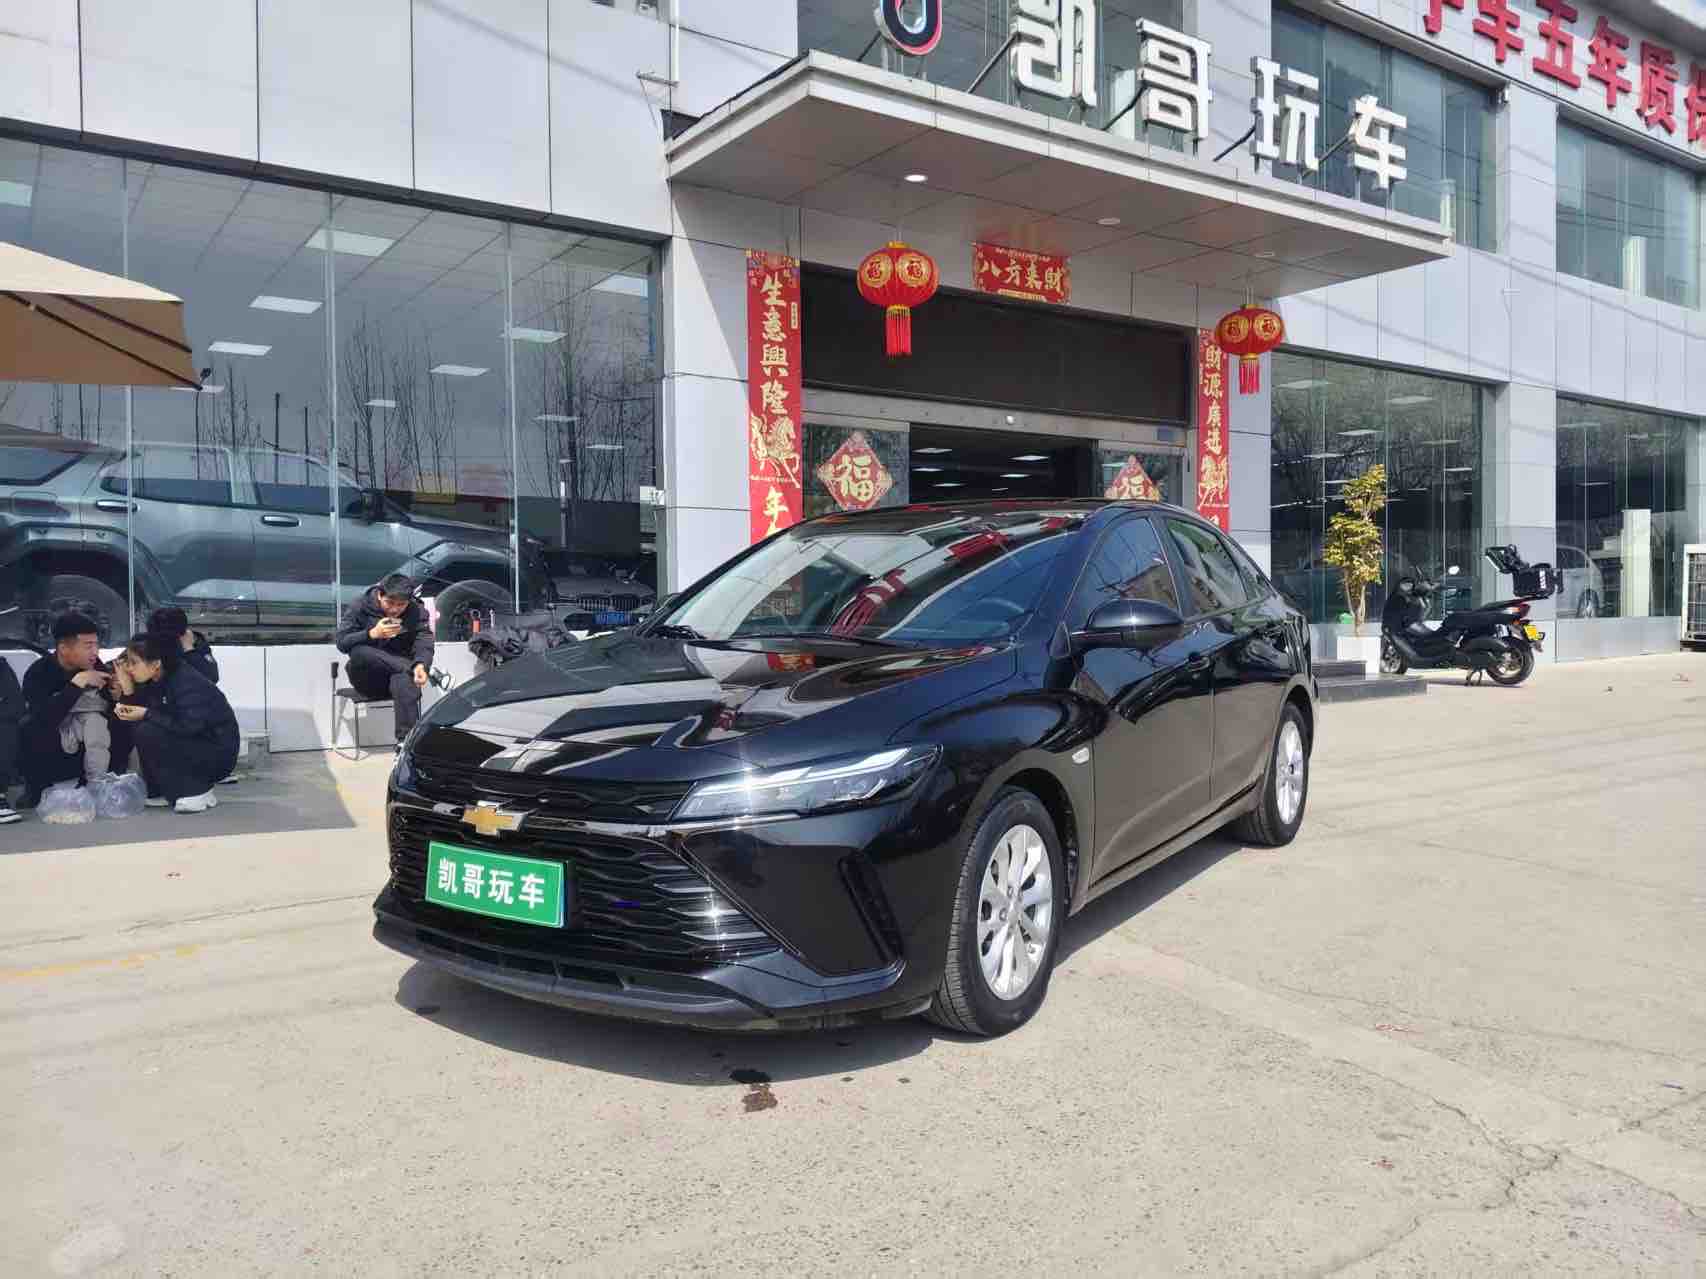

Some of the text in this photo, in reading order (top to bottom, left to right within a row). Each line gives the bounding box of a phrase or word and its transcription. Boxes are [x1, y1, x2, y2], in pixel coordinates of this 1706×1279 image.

[1010, 0, 1408, 190] 凯哥玩车
[836, 453, 875, 502] 福
[437, 856, 546, 910] 凯哥玩车
